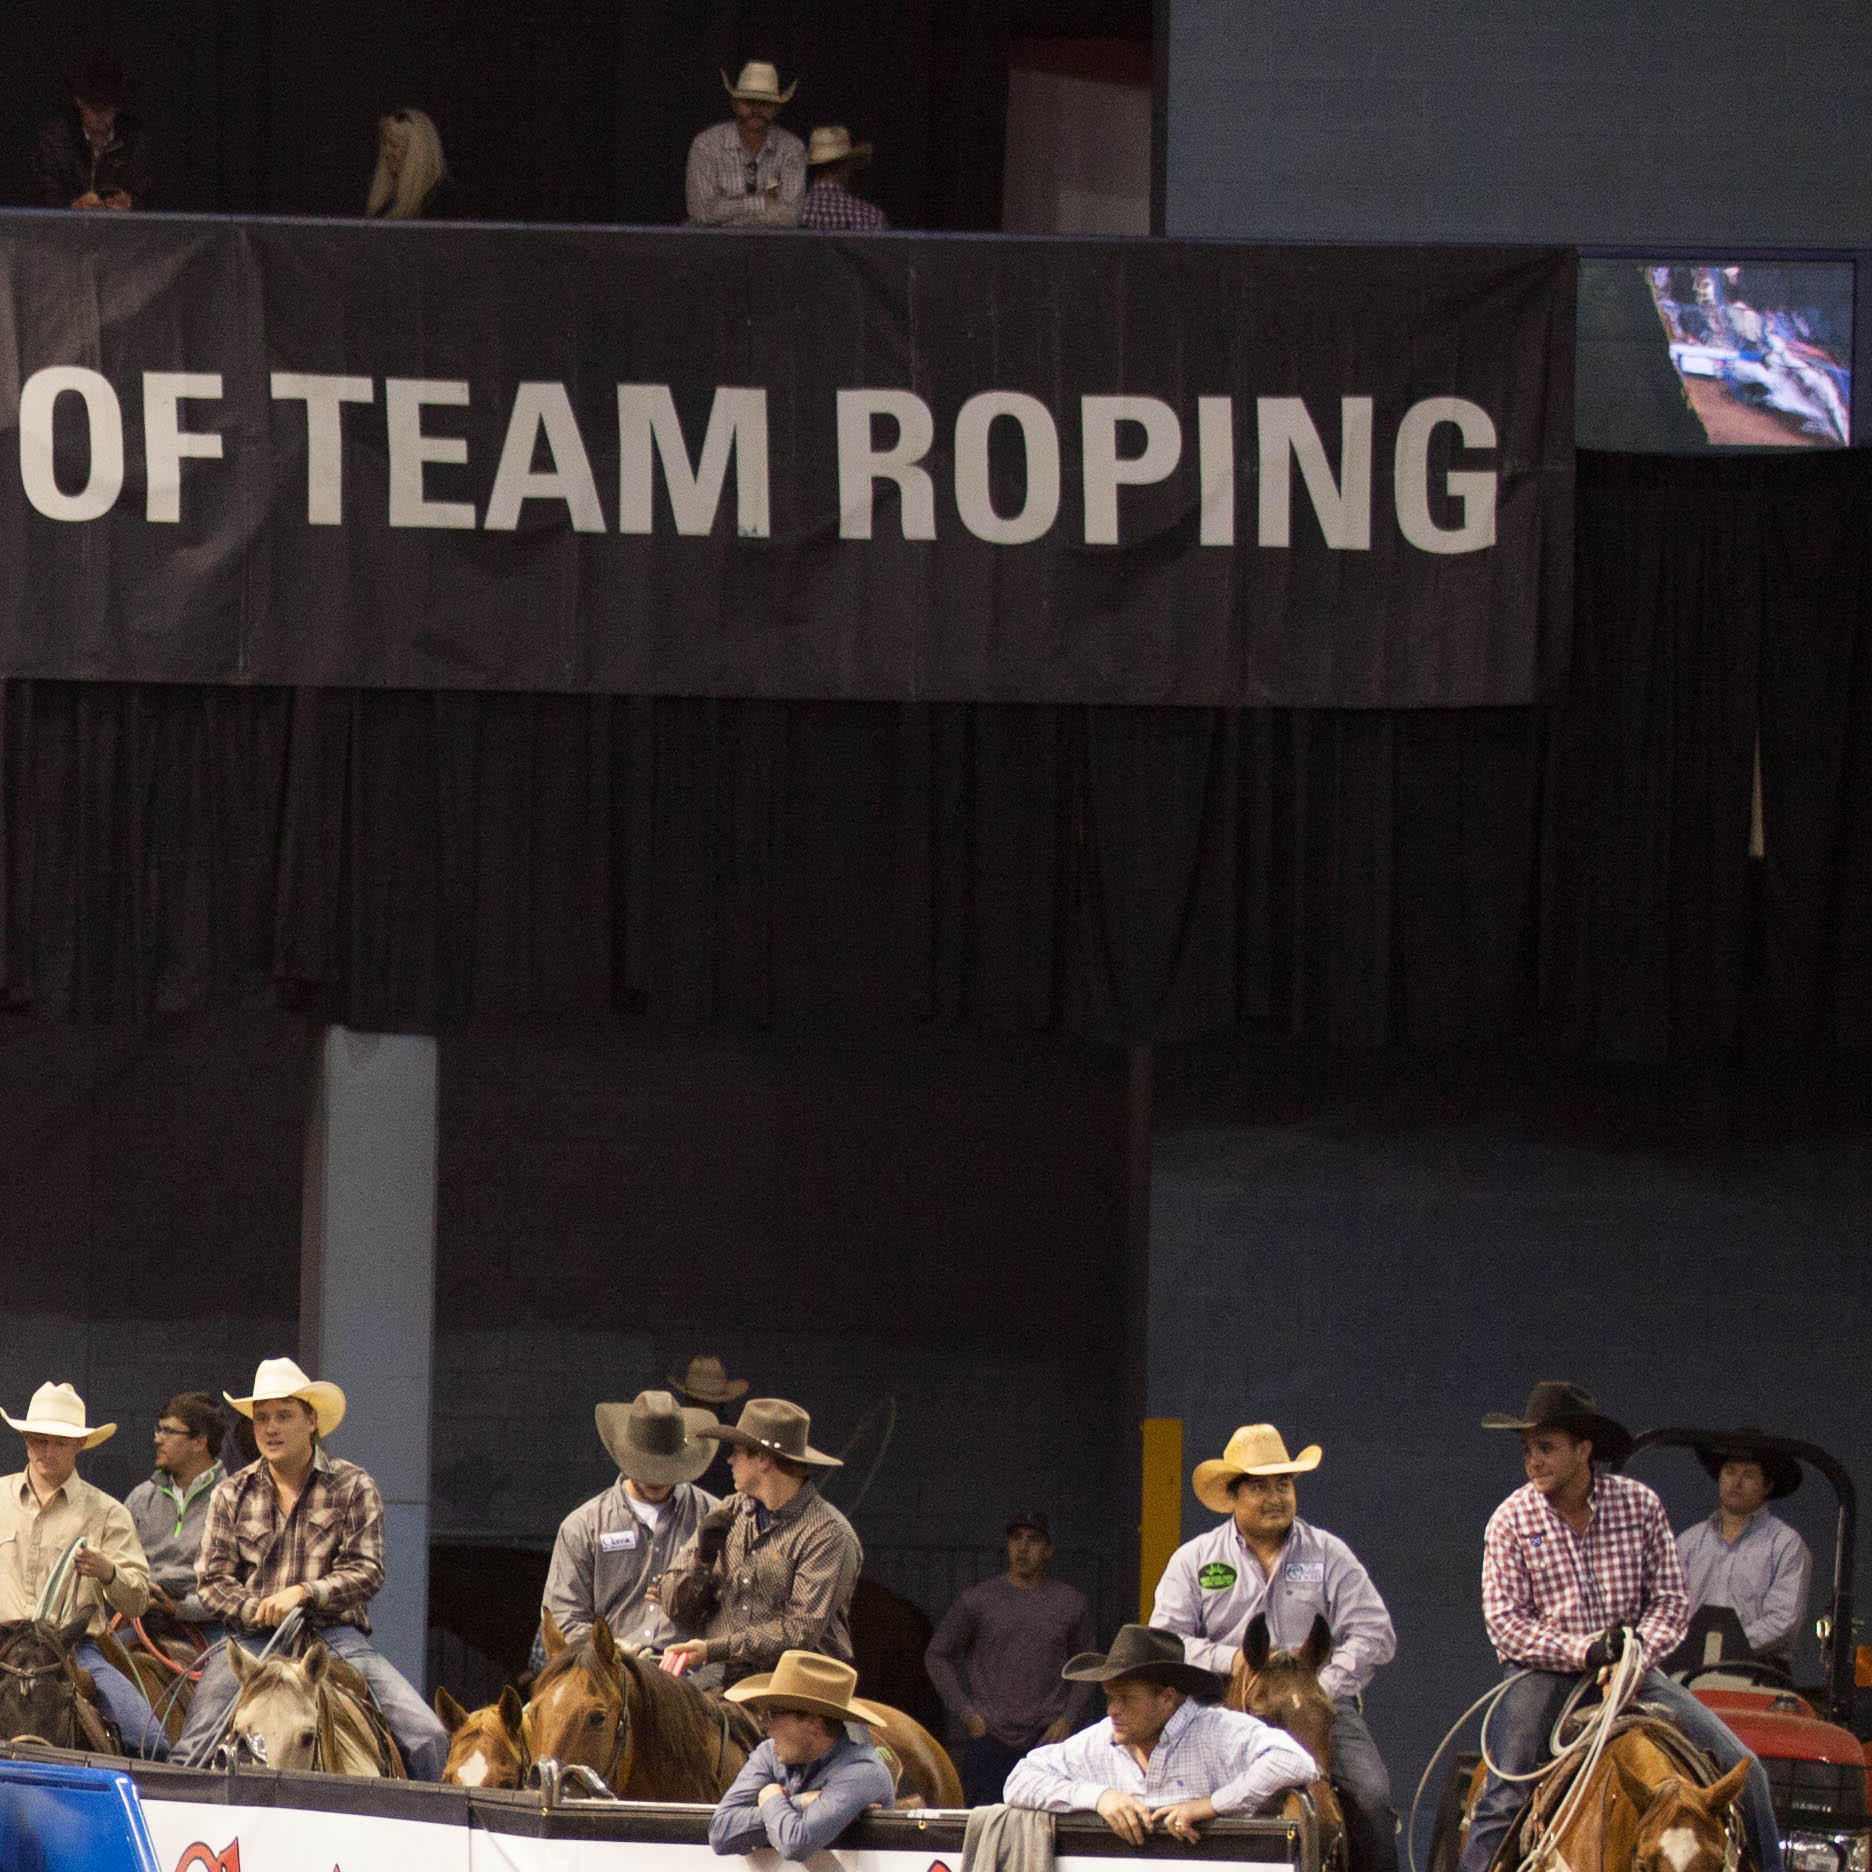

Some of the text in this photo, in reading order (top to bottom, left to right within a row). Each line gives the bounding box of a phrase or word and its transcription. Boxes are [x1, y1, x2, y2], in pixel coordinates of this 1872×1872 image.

[19, 365, 224, 524] OF
[272, 372, 771, 539] TEAM
[836, 387, 1499, 555] ROPING
